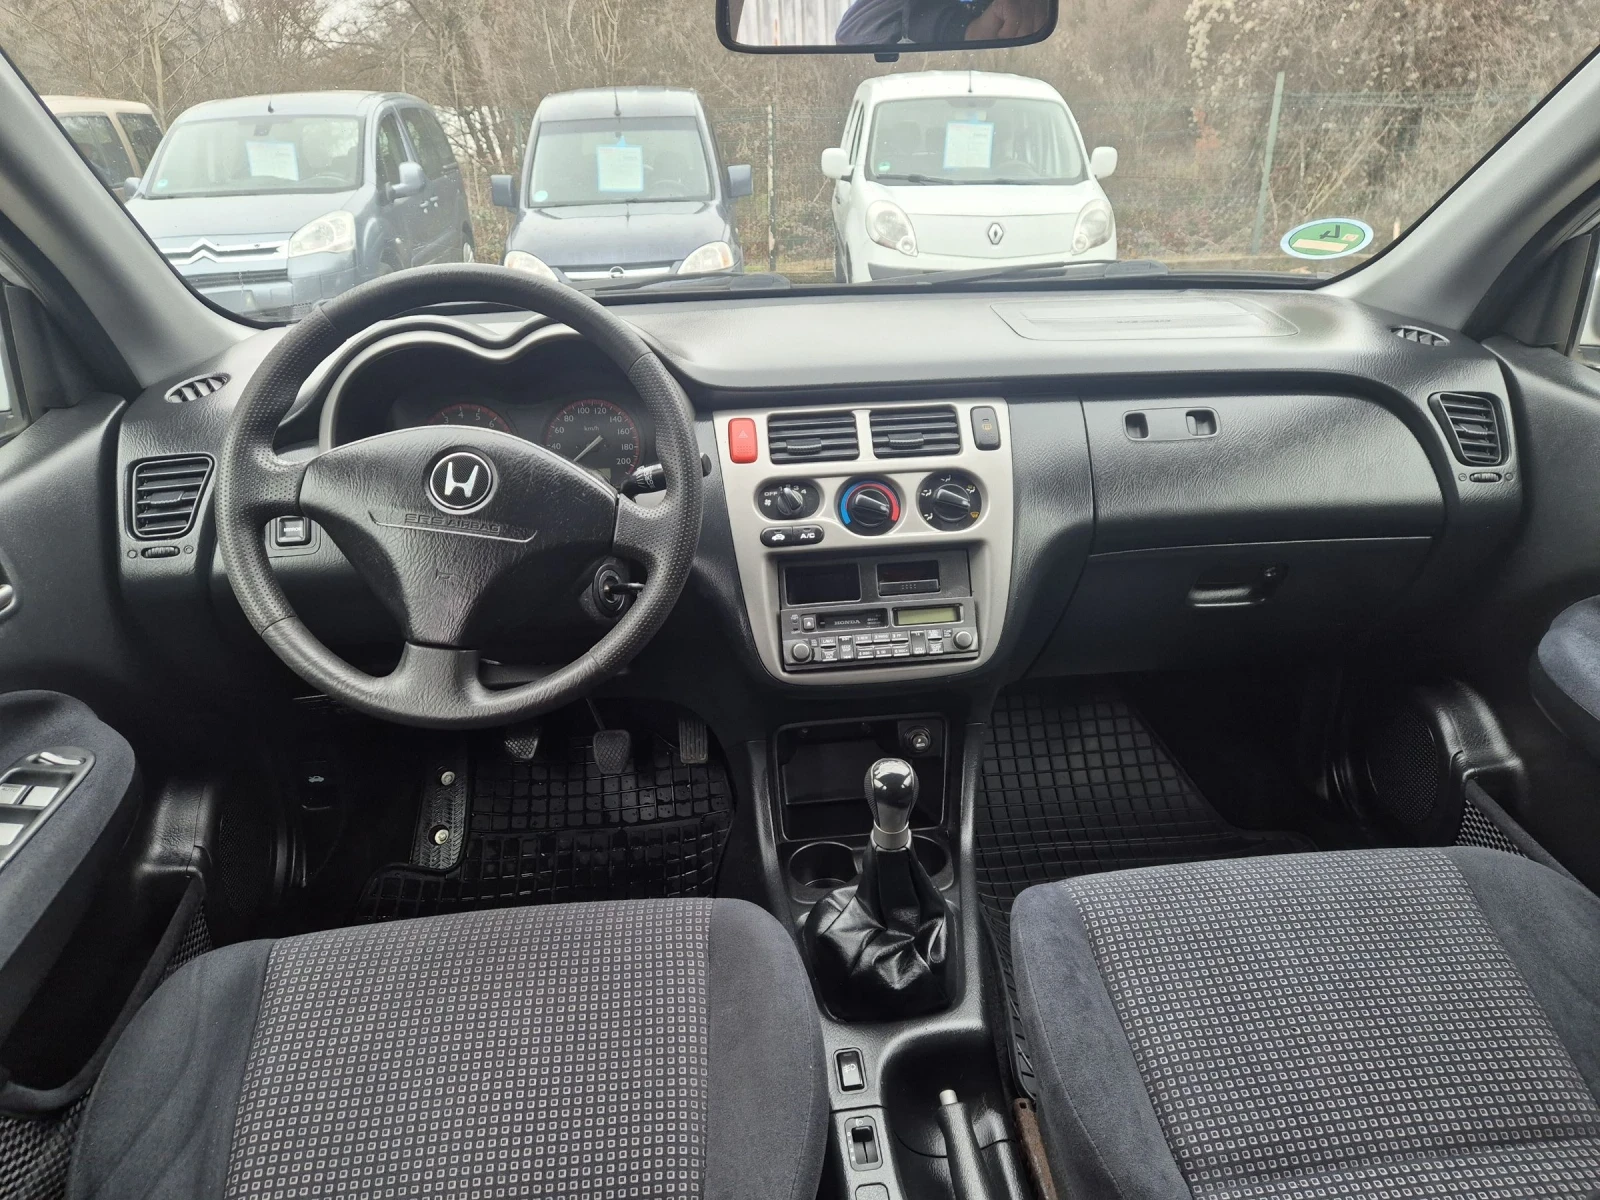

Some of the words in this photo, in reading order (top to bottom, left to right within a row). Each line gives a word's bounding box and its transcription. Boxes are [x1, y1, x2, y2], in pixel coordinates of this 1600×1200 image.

[458, 411, 464, 419] 4
[475, 413, 480, 421] 5
[609, 415, 623, 423] 140
[443, 416, 449, 424] 3
[488, 420, 494, 428] 6
[554, 426, 565, 434] 60
[617, 427, 630, 435] 160
[621, 443, 634, 451] 180
[616, 457, 632, 465] 200
[447, 519, 500, 534] AIRBAG
